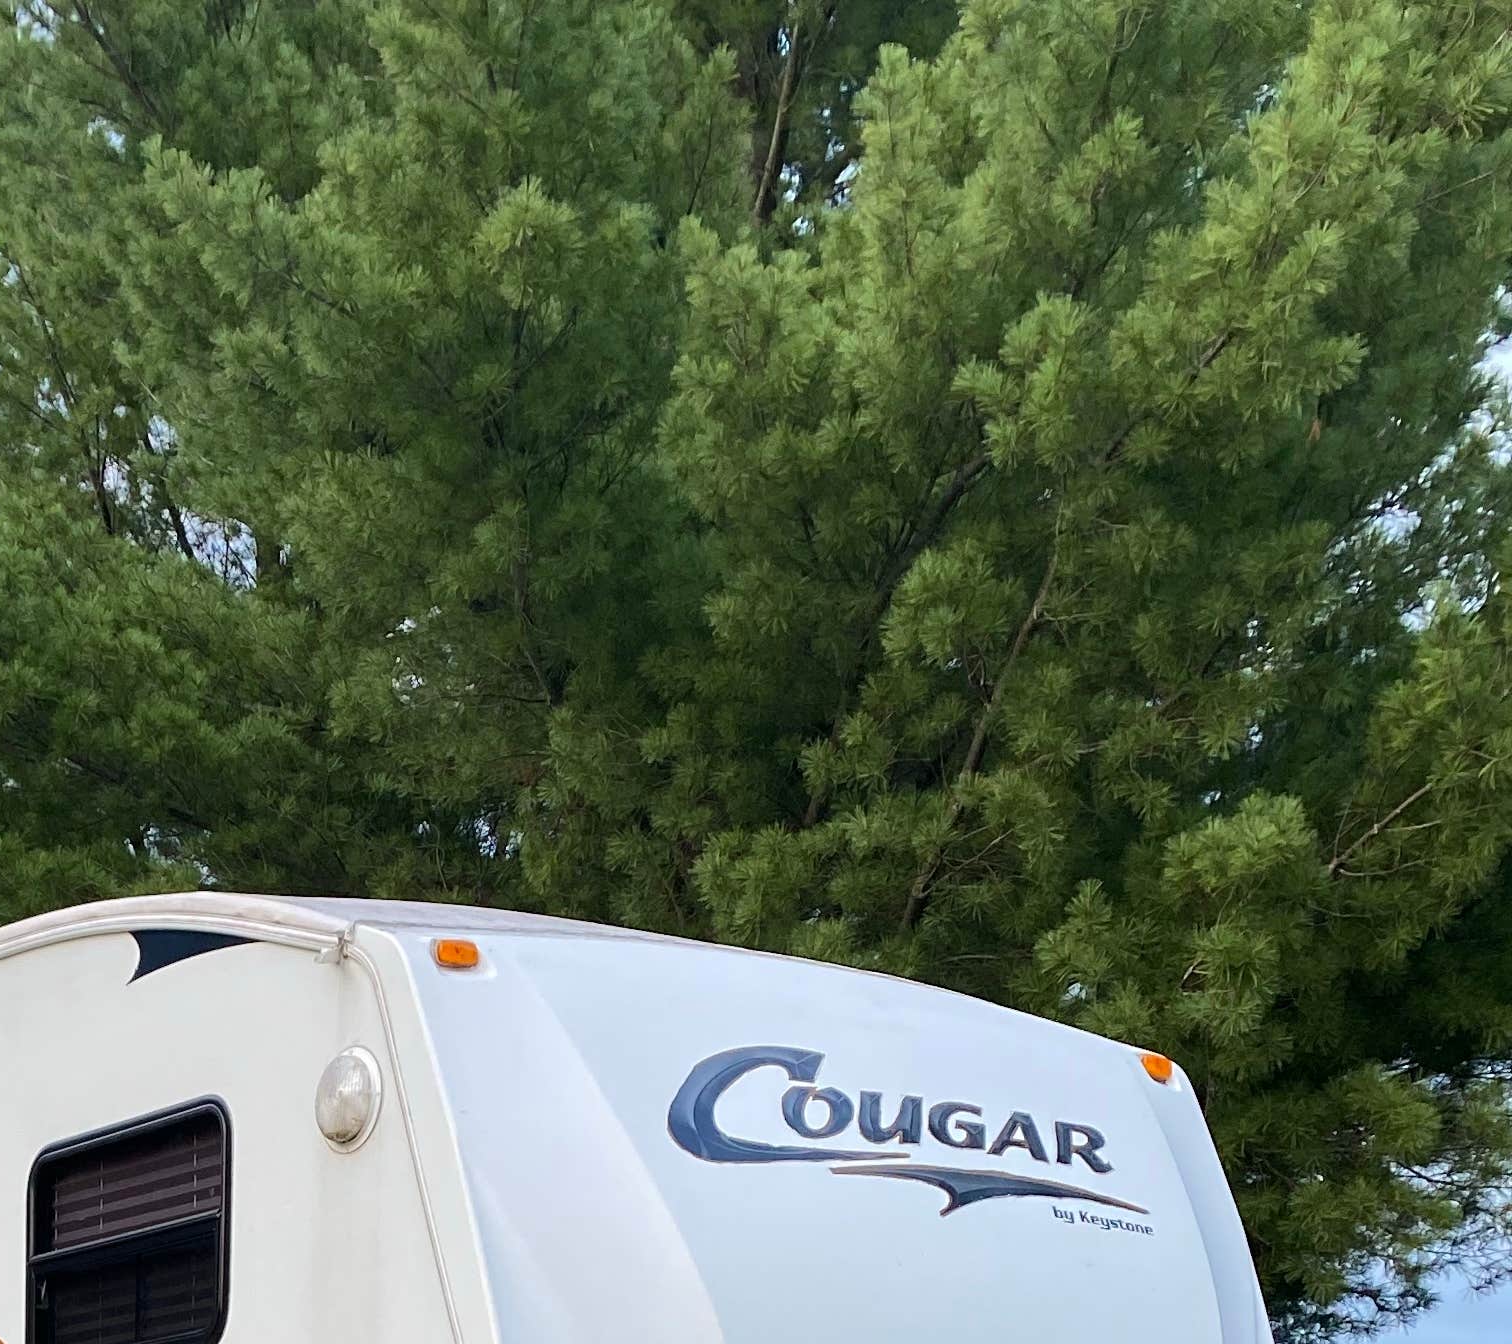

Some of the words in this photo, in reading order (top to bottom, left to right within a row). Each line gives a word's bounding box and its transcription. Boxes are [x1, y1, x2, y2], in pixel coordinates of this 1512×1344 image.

[666, 1044, 1114, 1175] COUGAR
[1051, 1205, 1075, 1225] by
[1078, 1209, 1155, 1236] Keystone
